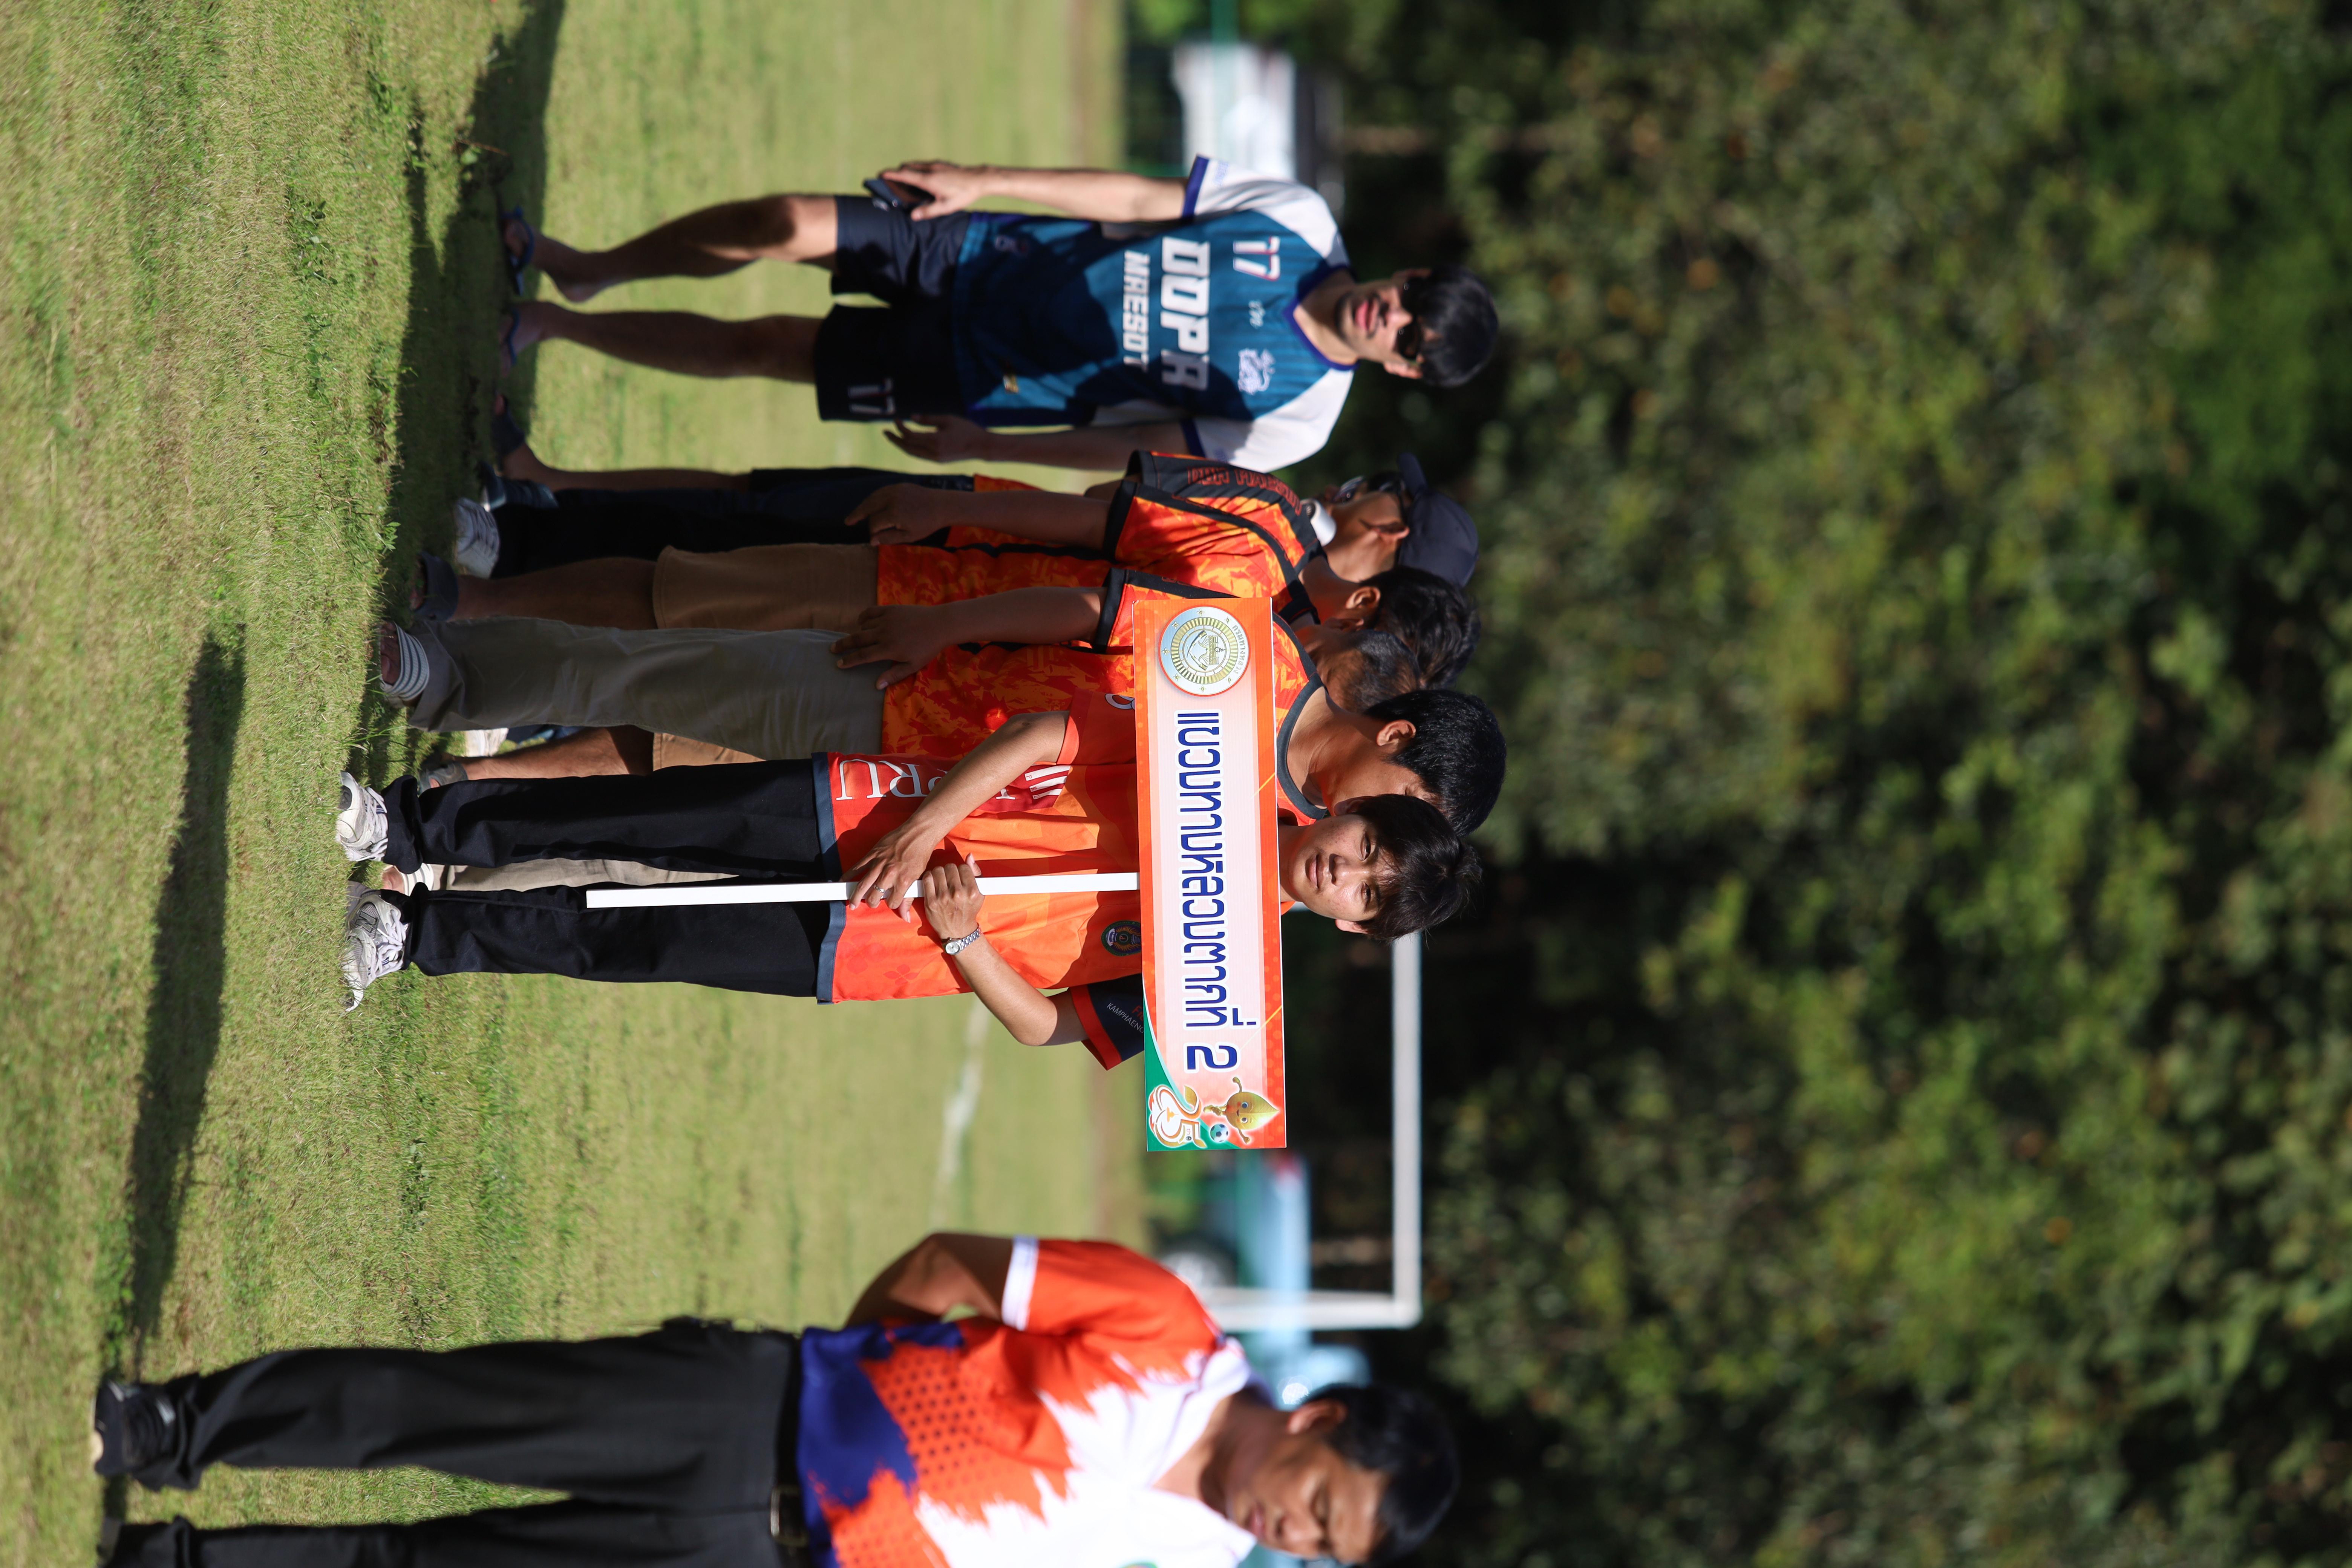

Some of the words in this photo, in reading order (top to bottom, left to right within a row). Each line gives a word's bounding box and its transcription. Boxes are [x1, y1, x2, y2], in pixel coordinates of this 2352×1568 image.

[1233, 236, 1281, 282] 17
[1122, 251, 1150, 372] MAESOT
[1160, 236, 1211, 391] DOPA
[848, 378, 895, 415] 17
[1232, 625, 1246, 674] กรมทางหลวง
[1177, 712, 1256, 1027] แขวงทางหลวงตากที่
[1187, 1045, 1237, 1070] 2
